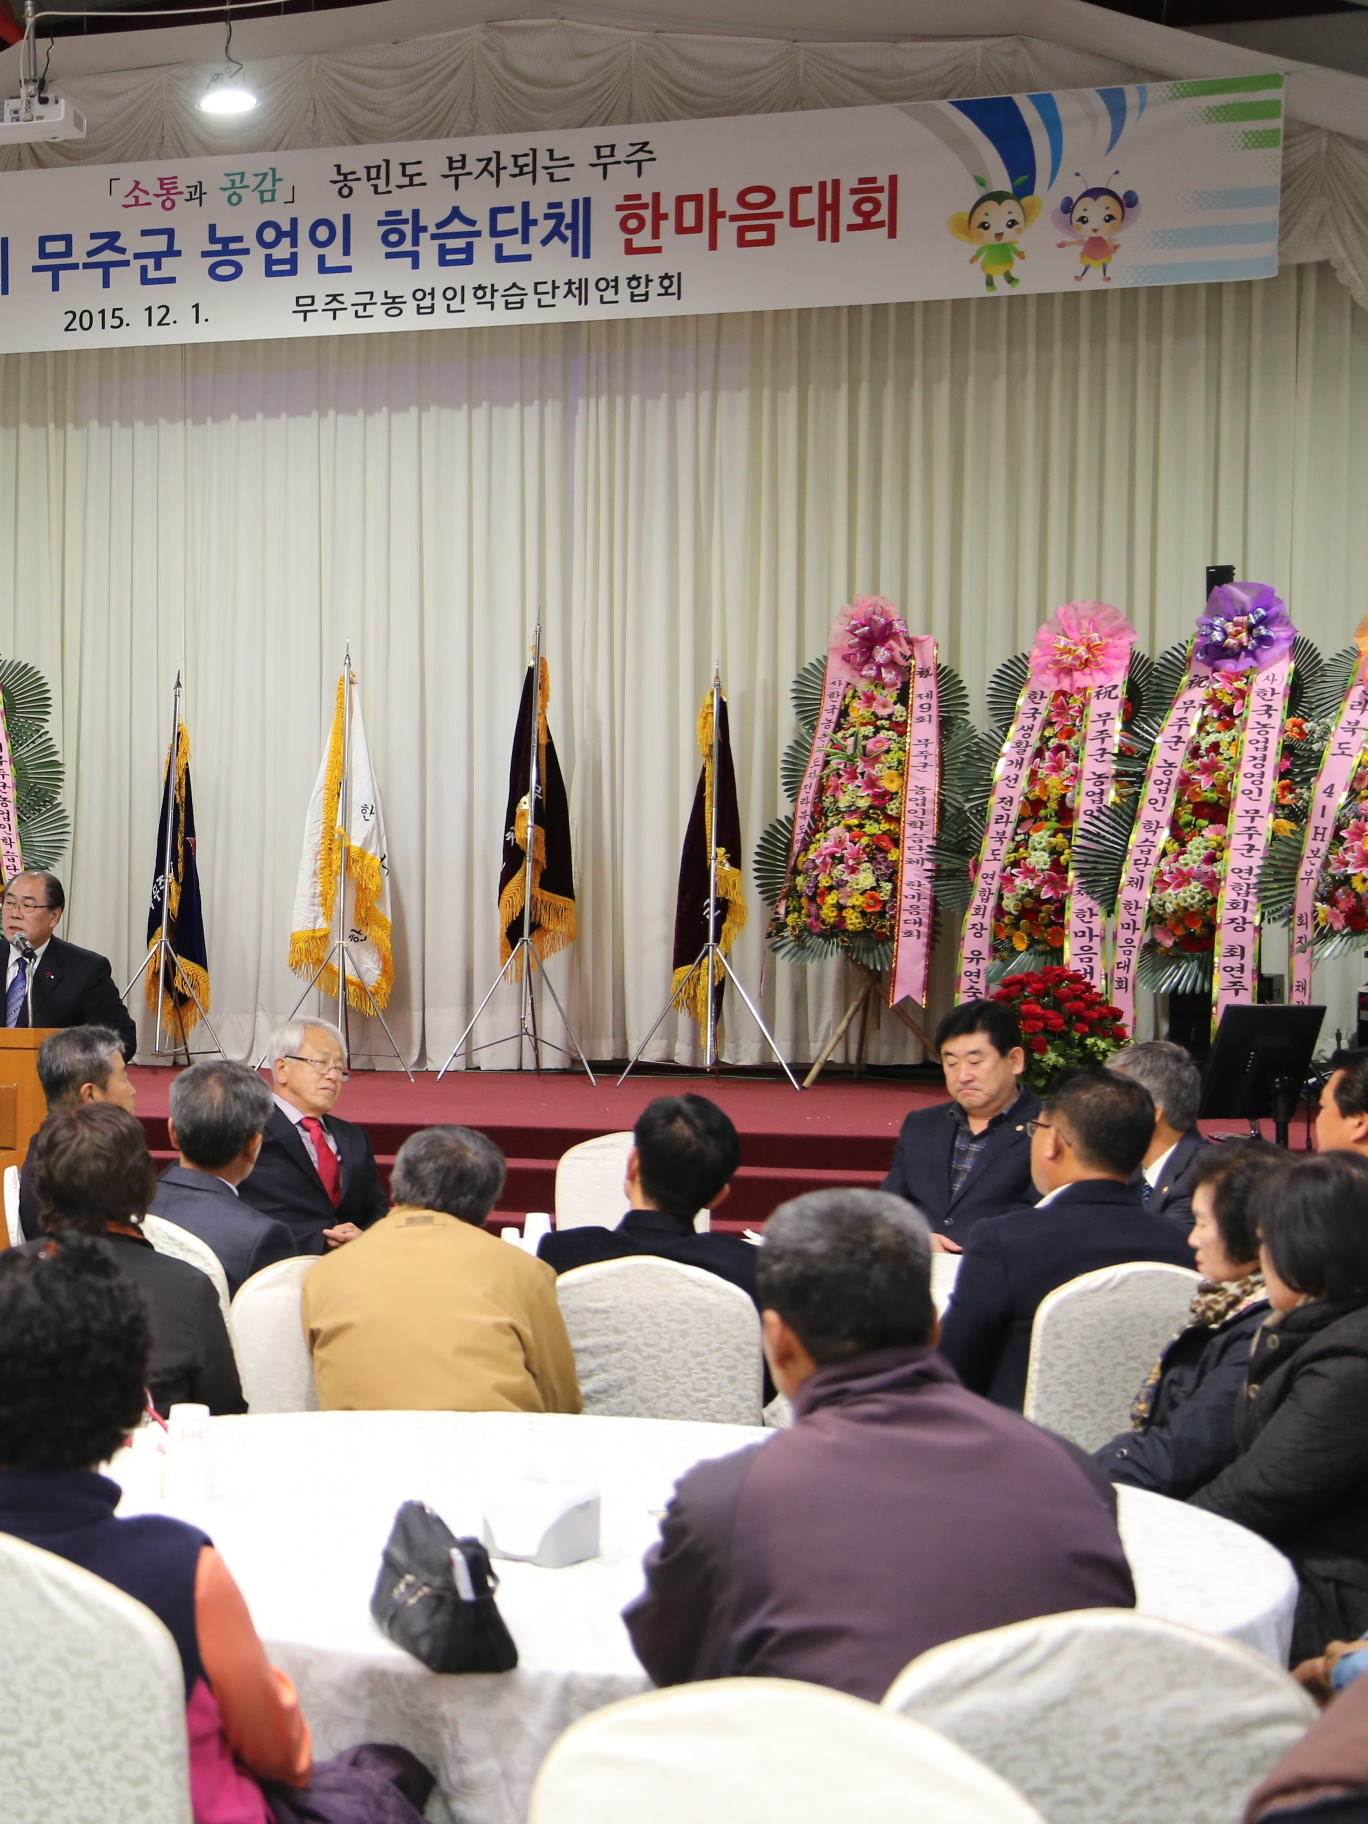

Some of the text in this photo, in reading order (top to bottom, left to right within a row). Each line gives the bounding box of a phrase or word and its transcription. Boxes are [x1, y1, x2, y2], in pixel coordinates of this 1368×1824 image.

[329, 158, 428, 199] 농민도
[440, 147, 576, 192] 부자되는
[588, 140, 657, 181] 무주
[31, 227, 182, 292] 무주군
[200, 213, 353, 282] 농업인
[376, 196, 592, 271] 학습단체
[614, 174, 899, 256] 한마음대회
[63, 302, 210, 332] 2015. 12. 1.
[291, 271, 683, 323] 무주군농업인학습단체연합회
[912, 690, 934, 725] 제9회
[1092, 684, 1121, 701] 祝
[1000, 689, 1049, 790] 한국생활개선
[1087, 711, 1116, 764] 무주군
[1163, 699, 1197, 751] 무주군
[909, 737, 934, 773] 무주군
[1147, 758, 1179, 813] 농업인
[984, 796, 1015, 863] 전라북도
[1126, 819, 1165, 893] 학습단체
[1231, 808, 1266, 858] 무주군
[900, 879, 928, 941] 한마음대회
[966, 870, 997, 939] 연합회장
[1222, 866, 1259, 933] 연합회장
[1114, 900, 1144, 994] 한마음대회
[1219, 945, 1250, 997] 최연주
